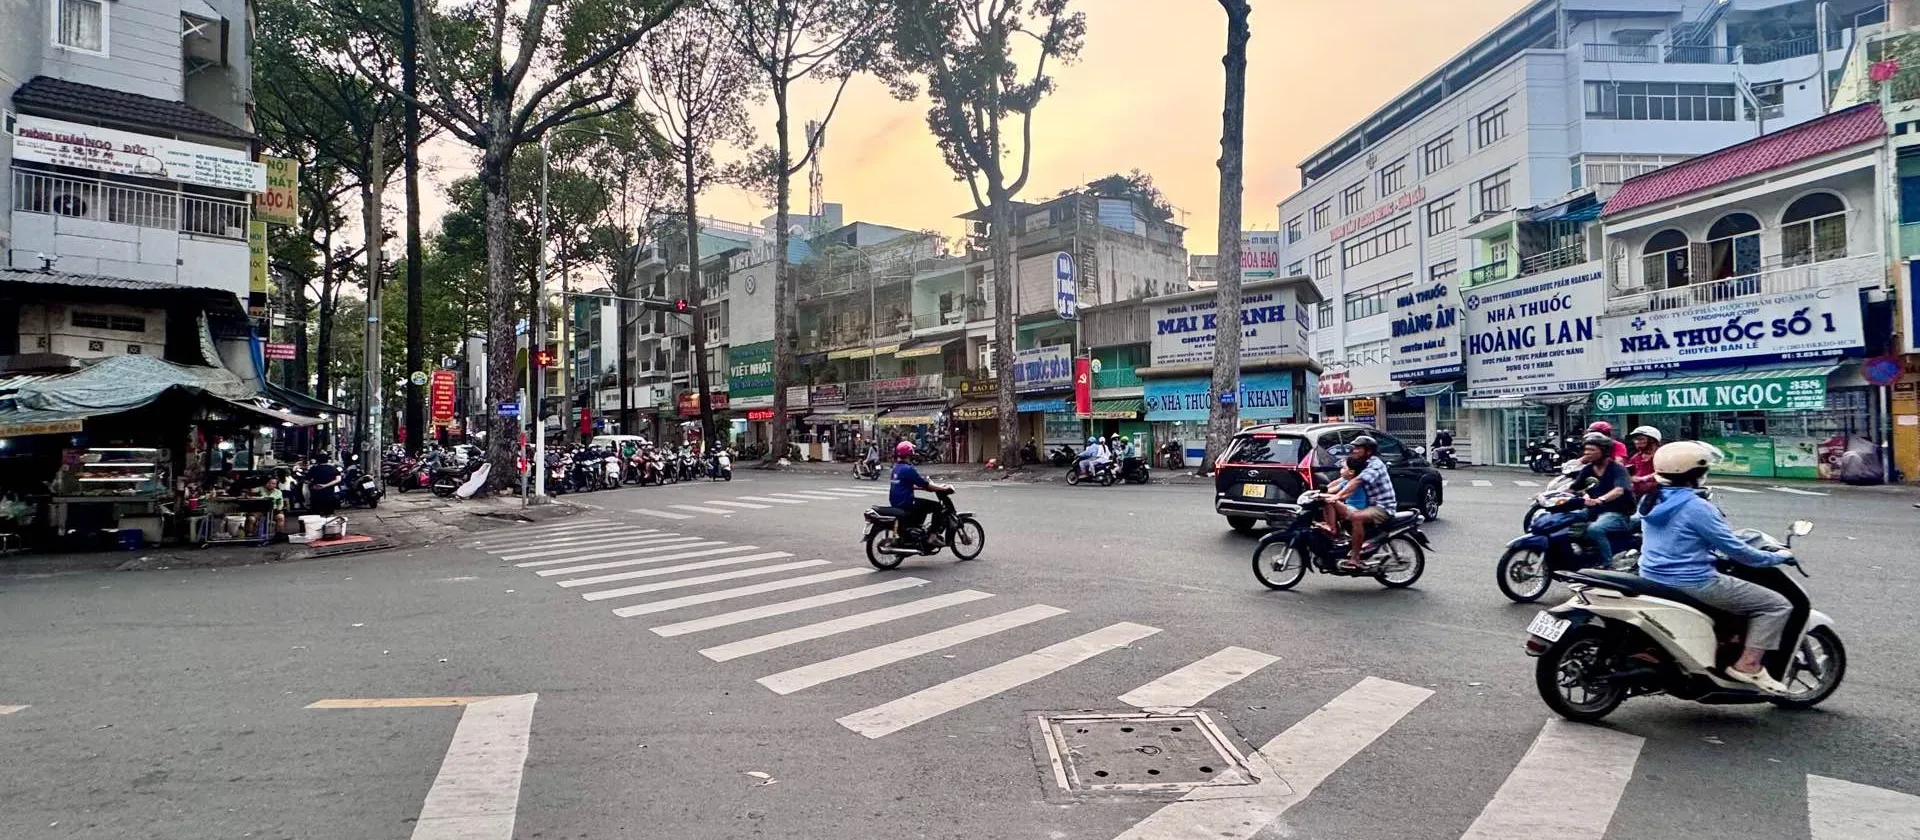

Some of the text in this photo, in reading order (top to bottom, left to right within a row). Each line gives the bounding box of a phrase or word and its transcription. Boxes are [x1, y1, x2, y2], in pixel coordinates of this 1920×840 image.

[19, 128, 53, 140] PHÒNG
[55, 132, 84, 146] KHÁM
[267, 160, 288, 174] NỘI
[267, 174, 293, 188] HẤT
[260, 188, 283, 212] LỘC
[1397, 283, 1447, 308] NHÀ THUỐC
[1481, 294, 1492, 304] CÔNG
[1554, 278, 1570, 289] PHẨM
[1571, 273, 1590, 285] HOÀNG
[1590, 271, 1602, 280] LAN
[1167, 304, 1188, 314] NHÀ
[1190, 301, 1217, 312] THUỐ
[1487, 292, 1572, 324] NHÀ THUỐC
[1693, 308, 1760, 322] TENDIPHAR CORP
[1694, 306, 1716, 317] PHẦN
[1720, 302, 1744, 312] DƯỢC
[1746, 298, 1772, 308] PHẨM
[1774, 294, 1802, 304] QUẬN
[1157, 316, 1198, 336] MAI
[1202, 304, 1285, 330] KANH
[1392, 304, 1455, 338] HOÀNG ÂN
[1620, 328, 1670, 353] NHÀ
[1673, 316, 1766, 348] THUỐC
[1772, 307, 1812, 338] SỐ
[1821, 312, 1836, 332] 1
[1470, 316, 1593, 356] HOÀNG LAN
[1400, 342, 1422, 354] CHUYÊN
[1530, 350, 1548, 360] PHẨM
[1549, 349, 1565, 358] CHỨC
[1566, 346, 1584, 356] NĂNG
[1678, 344, 1718, 356] CHUYÊN
[1720, 342, 1742, 352] BÁN
[730, 358, 772, 380] VIỆT NHẬT
[1161, 390, 1182, 411] NHÀ
[1185, 389, 1211, 410] THUỐ
[1248, 390, 1288, 408] KHANH
[1320, 382, 1331, 396] ÒA
[1616, 392, 1630, 406] NHÀ
[1630, 390, 1650, 406] THUỐC
[1650, 390, 1662, 406] TÂY
[1666, 386, 1709, 408] KIM
[1716, 383, 1783, 410] NGỌC
[1790, 379, 1820, 390] 358
